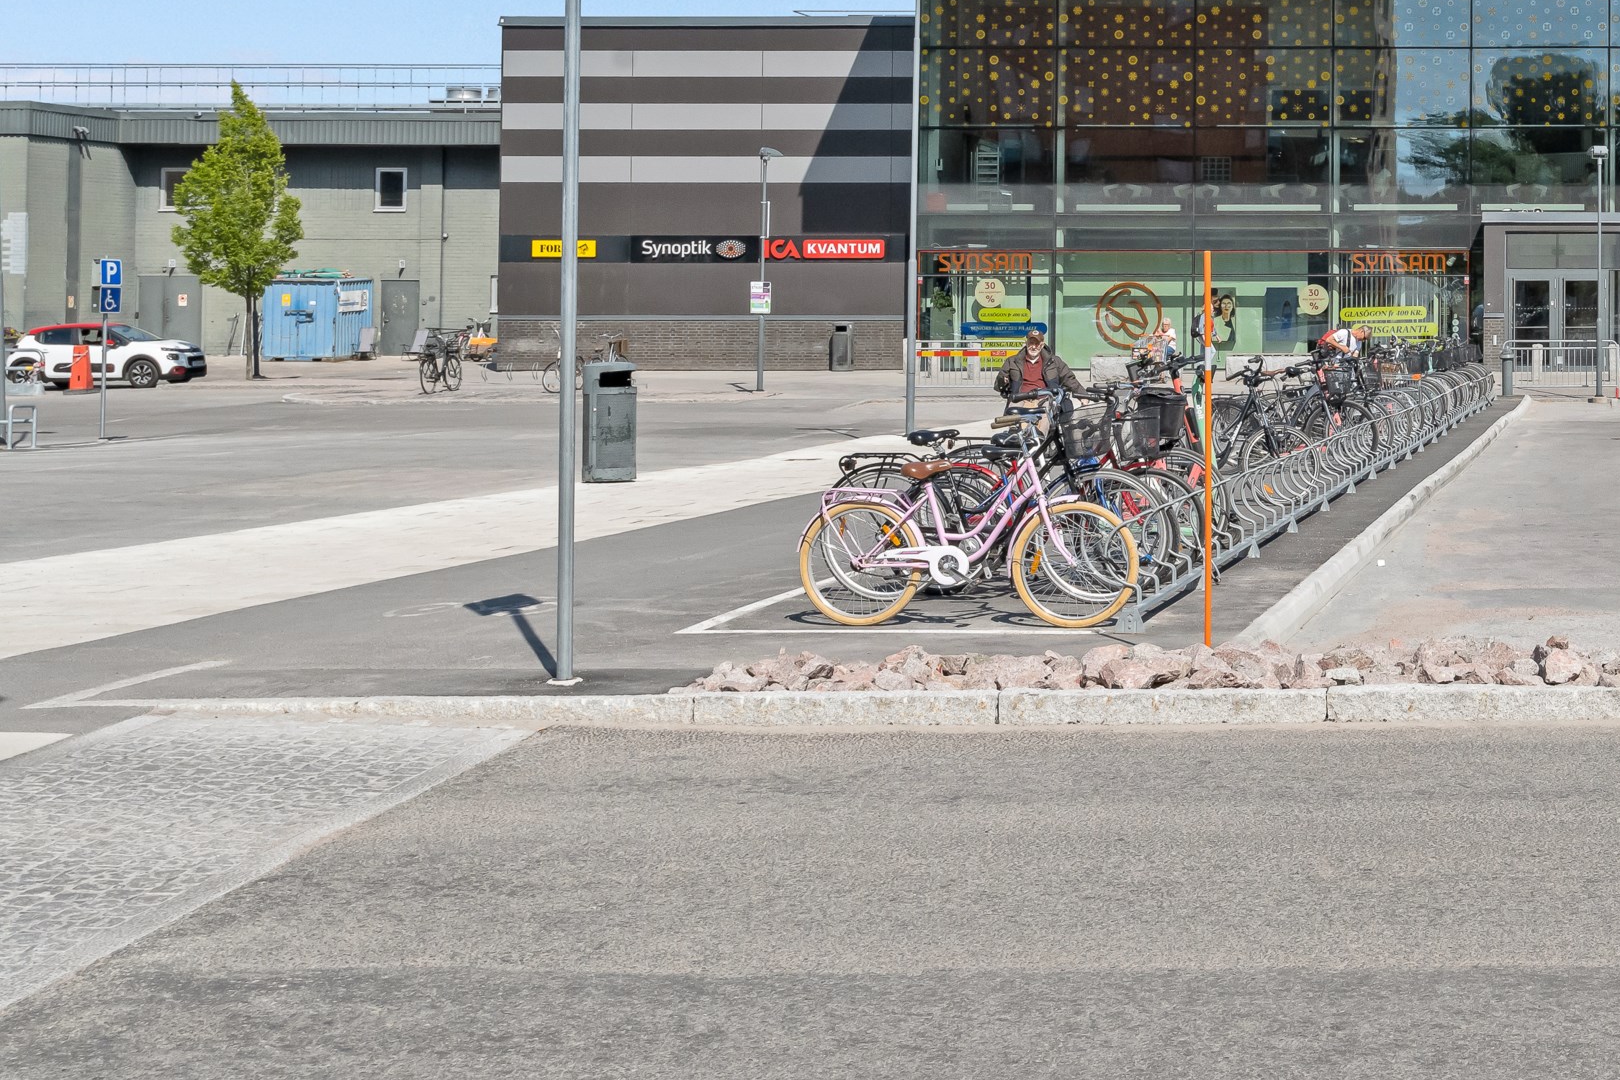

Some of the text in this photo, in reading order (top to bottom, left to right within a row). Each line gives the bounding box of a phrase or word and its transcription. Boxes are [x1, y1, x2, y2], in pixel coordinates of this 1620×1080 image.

[642, 240, 711, 257] Synoptik
[765, 239, 881, 259] ICA KVANTUM
[938, 253, 1033, 272] SYNSAM
[1353, 253, 1446, 274] SYNSAM
[106, 262, 117, 283] P
[1344, 309, 1388, 318] GLASÖGON
[1372, 325, 1429, 334] ISGARANTI.
